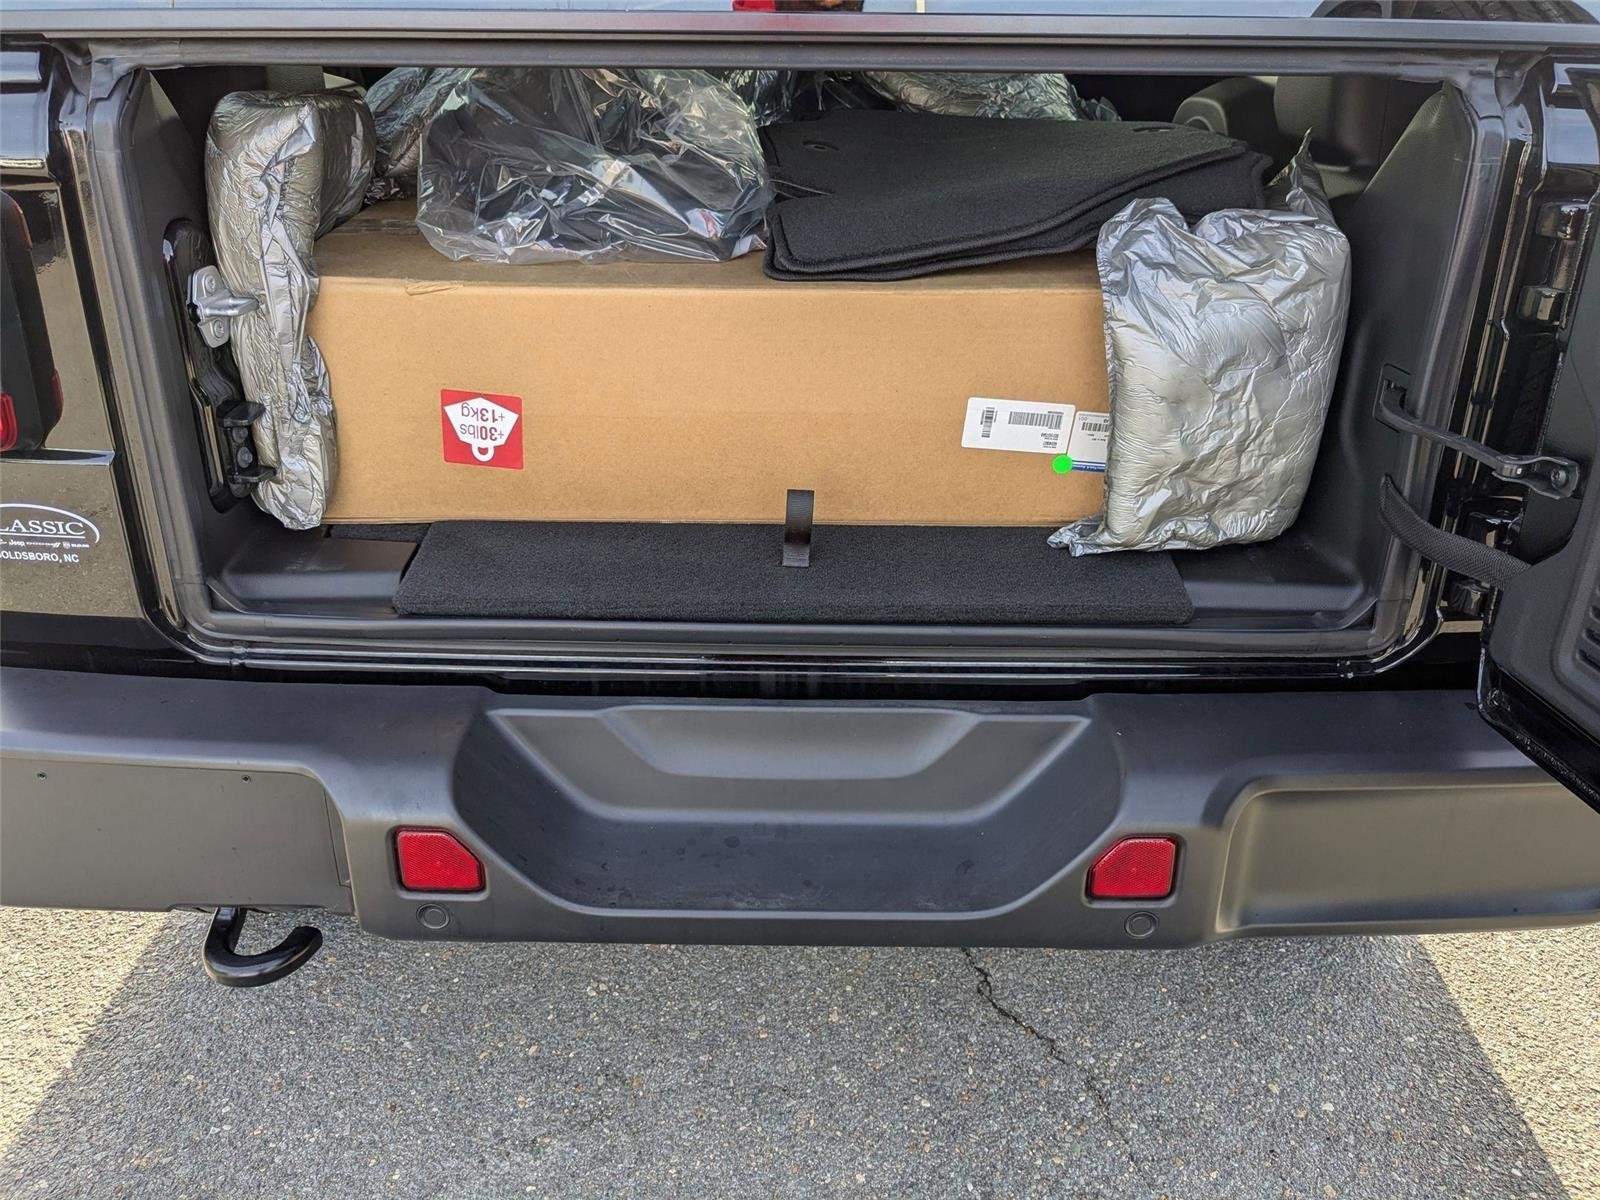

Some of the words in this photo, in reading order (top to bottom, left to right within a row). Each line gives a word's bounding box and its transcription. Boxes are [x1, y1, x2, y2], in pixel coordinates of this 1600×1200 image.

[461, 402, 505, 423] +13kg
[459, 423, 505, 441] +30lbs
[0, 550, 63, 563] OLDSBORO,
[64, 554, 79, 563] NC
